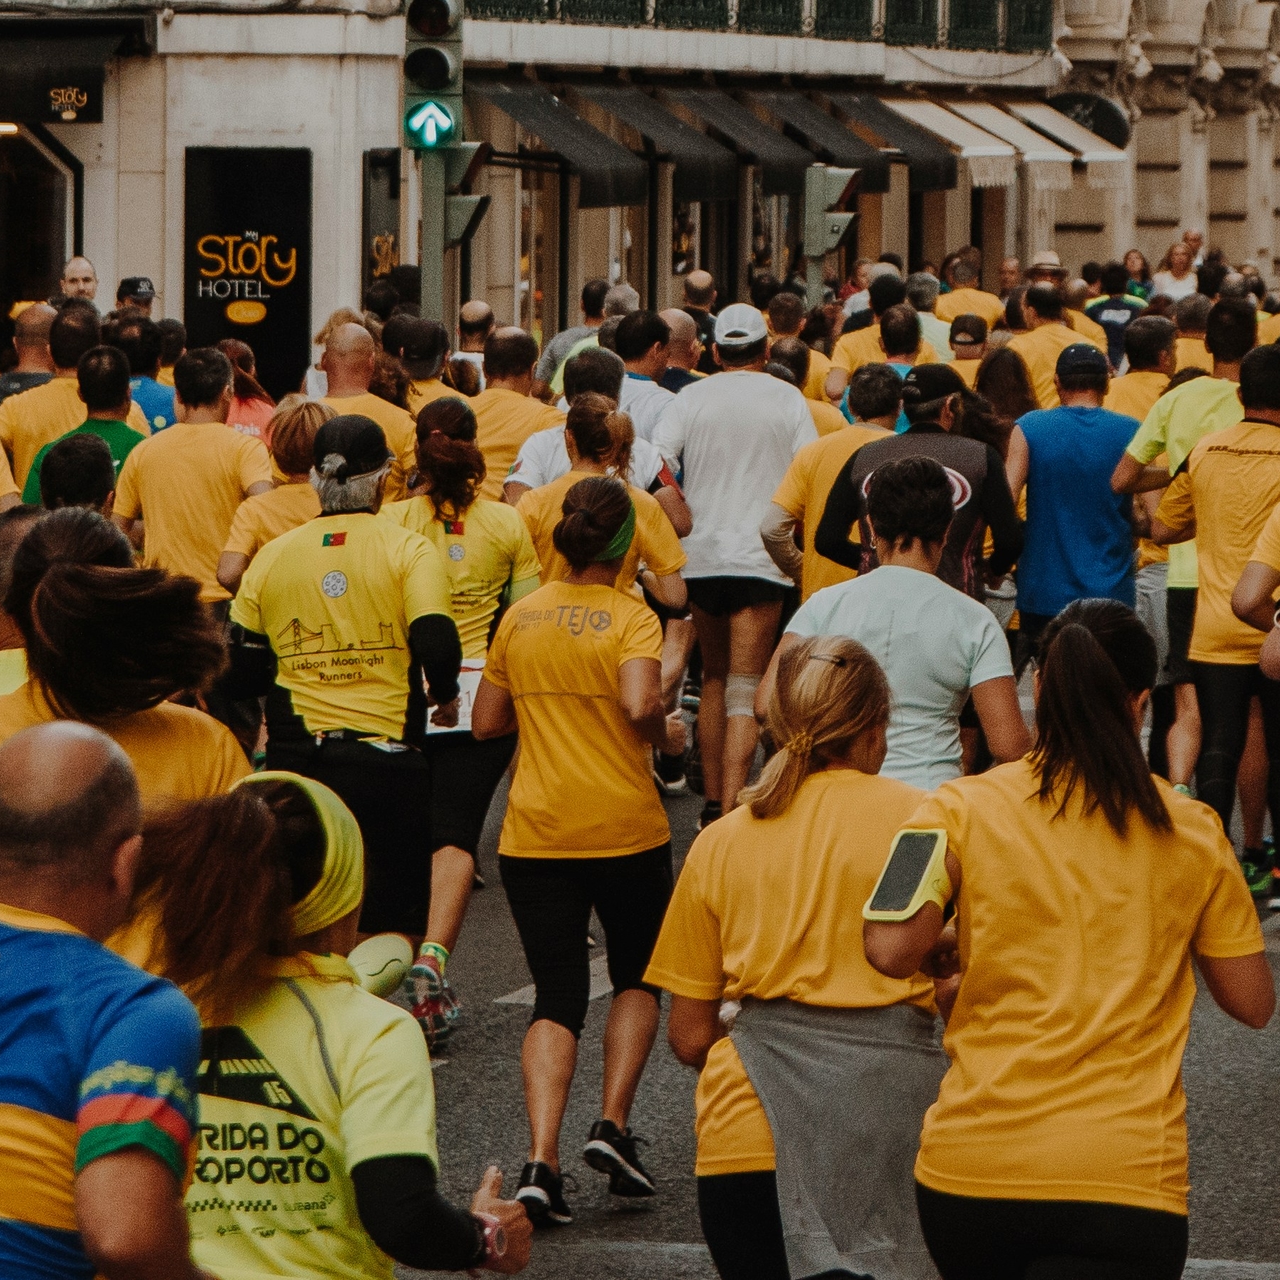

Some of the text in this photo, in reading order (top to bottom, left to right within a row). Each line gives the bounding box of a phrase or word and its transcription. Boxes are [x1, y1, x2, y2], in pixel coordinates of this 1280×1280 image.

[198, 278, 271, 299] HOTEL
[292, 660, 327, 671] Lisbon
[320, 671, 362, 681] Runners
[263, 1081, 292, 1104] 15
[198, 1122, 325, 1155] RIDA DO
[195, 1156, 331, 1185] OPORTO
